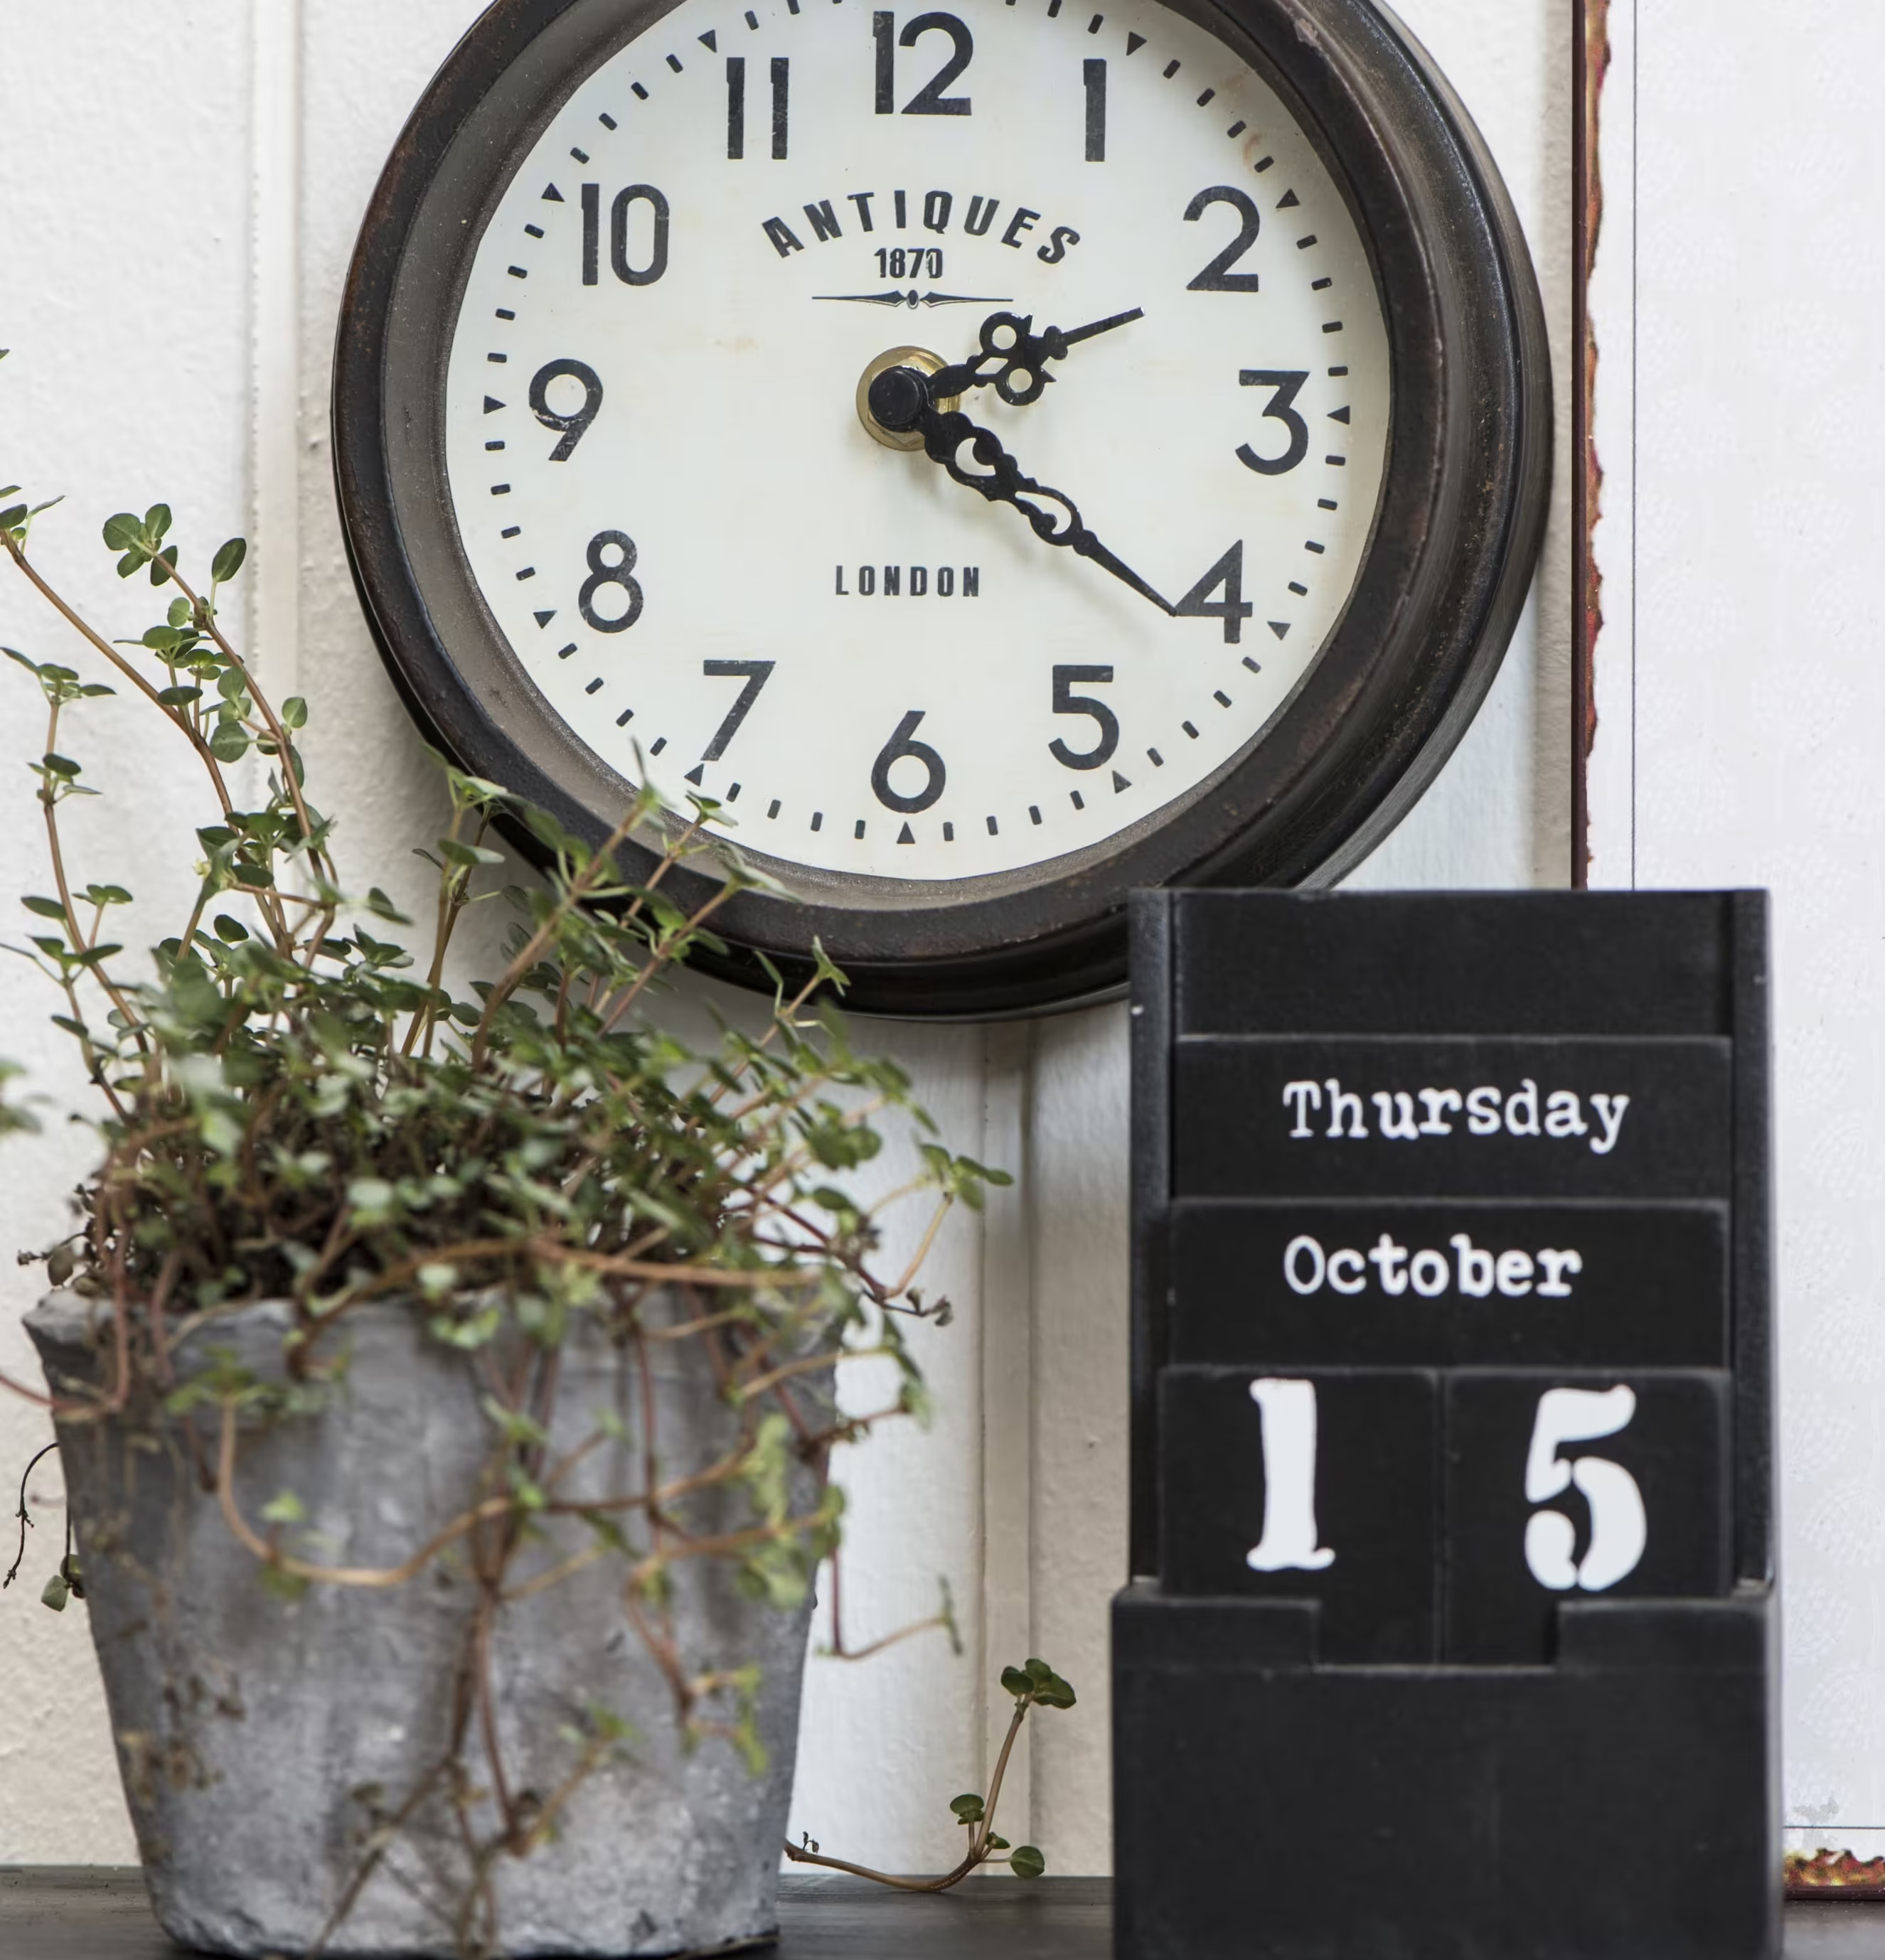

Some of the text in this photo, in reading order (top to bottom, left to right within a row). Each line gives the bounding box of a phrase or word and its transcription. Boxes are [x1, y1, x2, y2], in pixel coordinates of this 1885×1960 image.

[726, 57, 789, 160] 11
[872, 11, 973, 116] 12
[1083, 58, 1107, 162] 1
[581, 183, 670, 286] 10
[761, 190, 1081, 264] ANTIQUES
[874, 247, 944, 279] 1870
[1183, 186, 1260, 293] 2
[529, 358, 604, 462] 9
[1235, 370, 1310, 476] 3
[578, 530, 644, 634] 8
[835, 564, 980, 598] LONDON
[1176, 539, 1254, 644] 4
[703, 660, 776, 761] 7
[871, 710, 946, 814] 6
[1048, 665, 1120, 771] 5
[1282, 1078, 1630, 1155] Thursday
[1283, 1233, 1582, 1297] October
